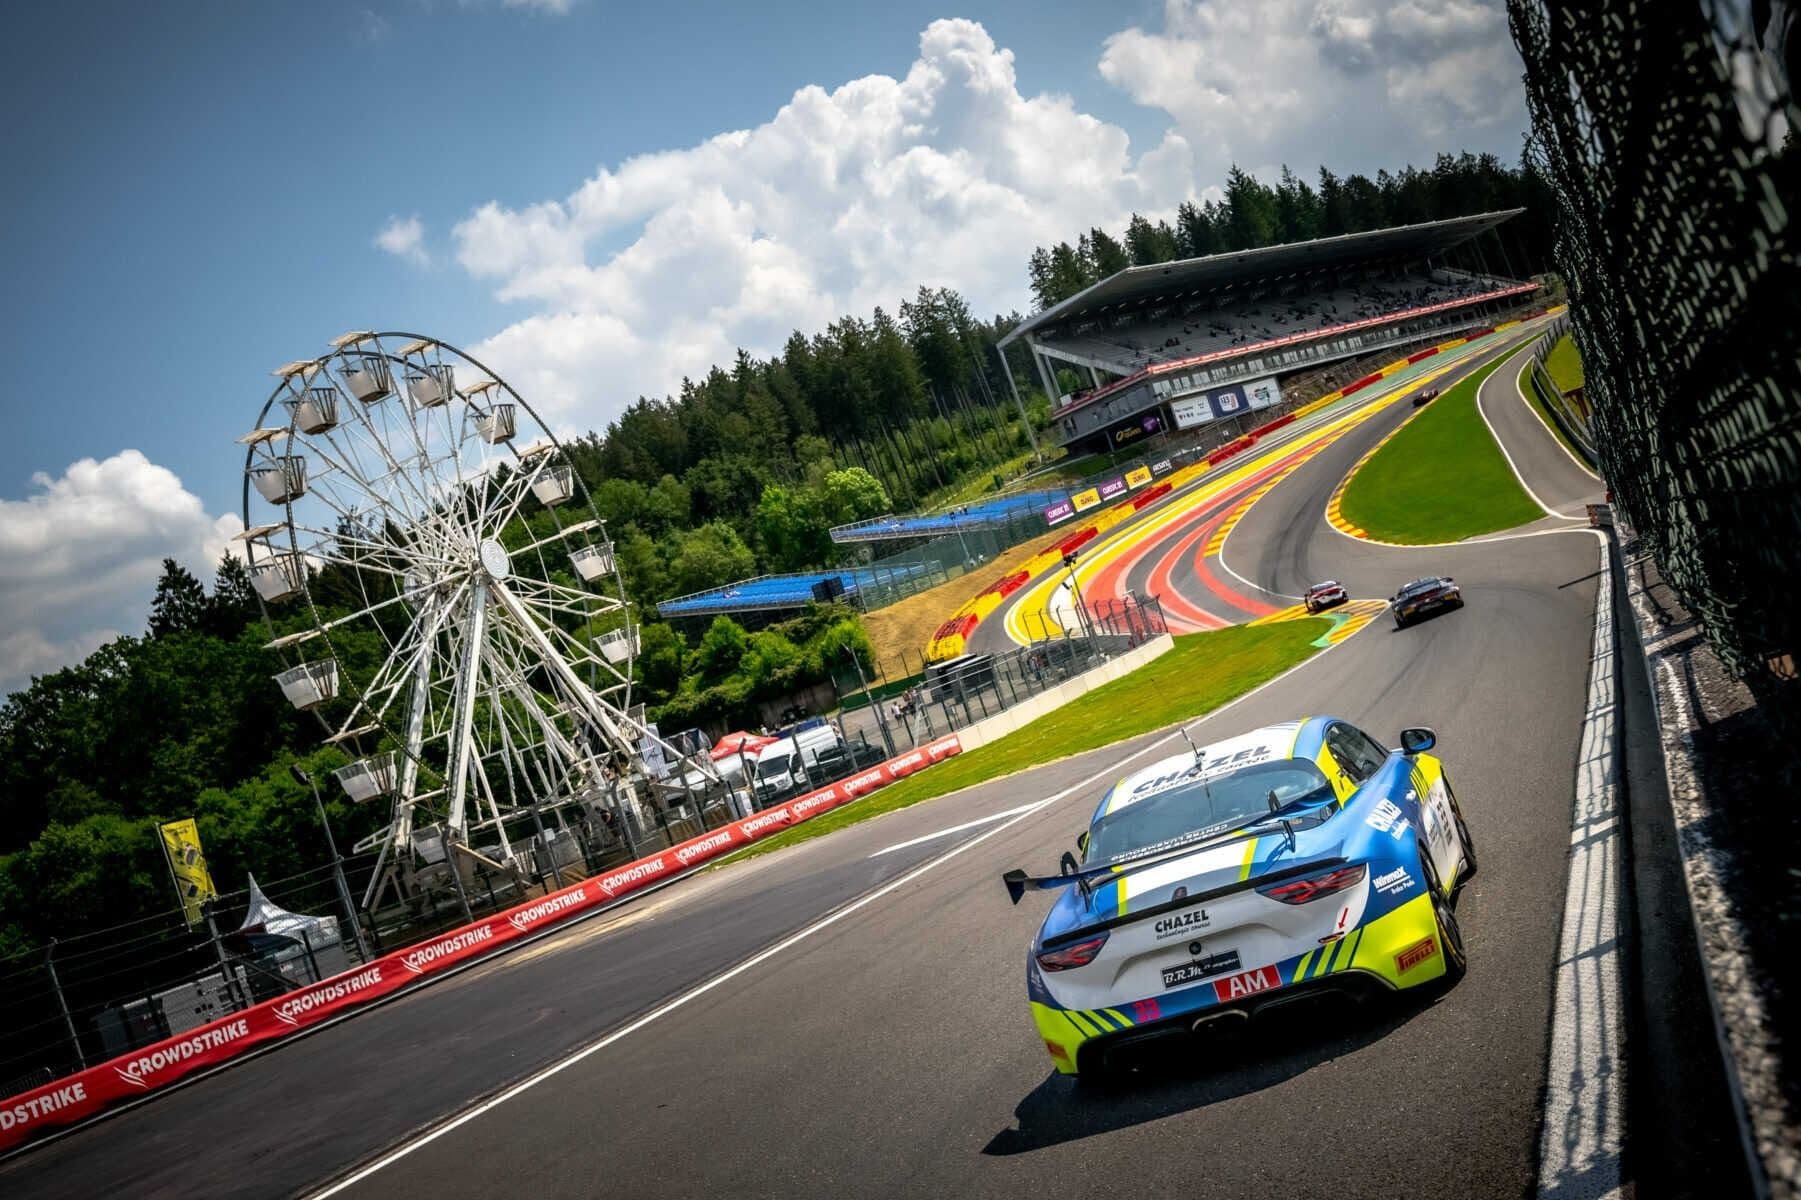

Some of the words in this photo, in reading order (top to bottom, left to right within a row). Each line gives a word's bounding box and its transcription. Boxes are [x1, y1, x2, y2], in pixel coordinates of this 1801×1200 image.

[1132, 745, 1272, 794] CHAZEL
[795, 789, 837, 813] CROWDSTRIKE
[743, 808, 791, 834] CROWDSTRIKE
[680, 831, 732, 860] CROWDSTRIKE
[602, 858, 665, 891] CROWDSTRIKE
[514, 889, 587, 926] CROWDSTRIKE
[1155, 909, 1209, 933] CHAZEL
[408, 925, 494, 967] CROWDSTRIKE
[1398, 938, 1435, 971] PIRELLI
[281, 967, 383, 1017] CROWDSTRIKE
[1229, 970, 1270, 998] AM
[127, 1018, 250, 1079] CROWDSTRIKE
[0, 1082, 87, 1130] DSTRIKE
